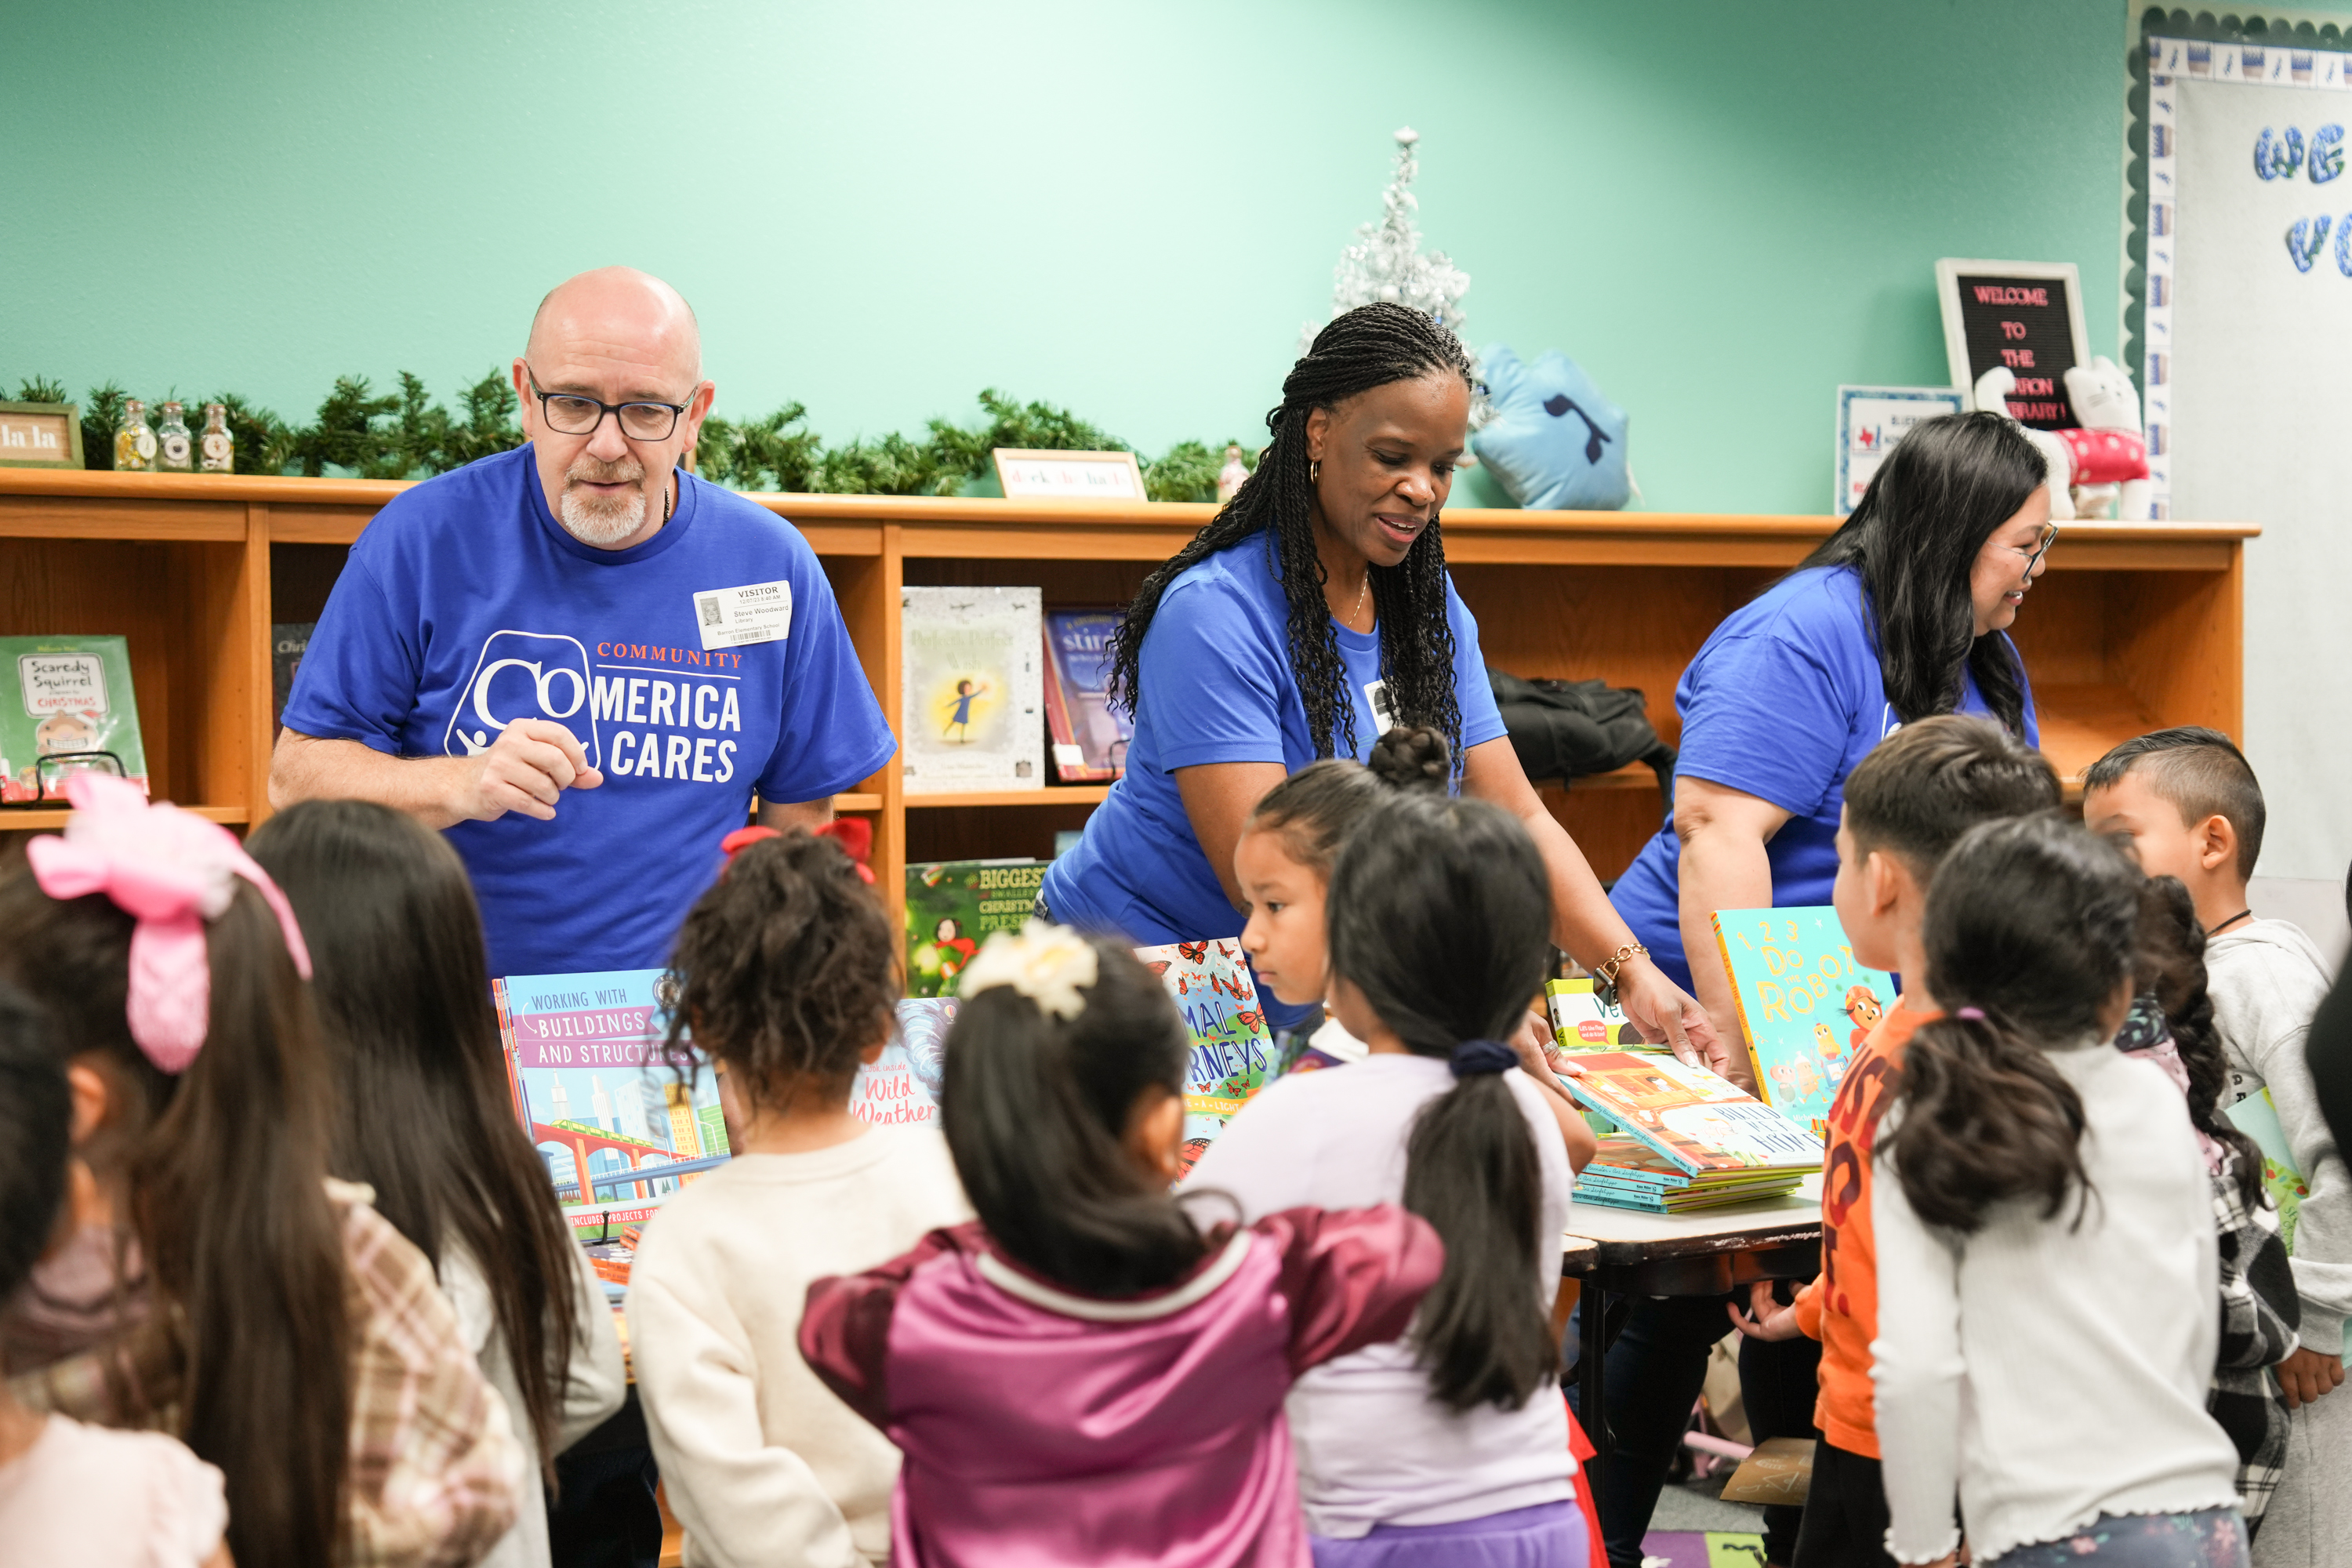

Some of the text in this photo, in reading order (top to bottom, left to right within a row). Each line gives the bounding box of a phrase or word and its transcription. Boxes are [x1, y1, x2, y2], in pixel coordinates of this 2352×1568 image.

[2254, 122, 2345, 183] WE
[1973, 285, 2048, 306] WELCOME
[2001, 321, 2027, 339] TO
[2001, 349, 2035, 368] THE
[2, 424, 56, 448] la la
[738, 586, 779, 598] VISITOR
[754, 604, 789, 615] Woodward
[735, 625, 762, 633] Elementary
[597, 641, 742, 668] COMMUNITY
[31, 660, 89, 676] Scaredy
[34, 675, 93, 688] Squirrel
[38, 697, 96, 708] CHRISTMAS
[611, 731, 737, 783] CARES
[979, 899, 1035, 914] CHRISTM
[1784, 975, 1802, 985] THE
[532, 989, 628, 1011] WORKING WITH
[1728, 972, 1735, 984] DO
[1737, 1003, 1748, 1029] ROBOT
[538, 1011, 645, 1038] BUILDINGS
[539, 1044, 688, 1063] AND STRUCTURES
[1186, 1037, 1267, 1083] RNEYS
[864, 1062, 907, 1073] Look inside
[866, 1073, 916, 1102] Wild
[853, 1099, 936, 1126] Weather
[1590, 1100, 1602, 1114] Emily
[1712, 1106, 1781, 1120] BUILD
[1745, 1120, 1777, 1132] ME
[1793, 1113, 1819, 1122] Michelle
[1749, 1132, 1825, 1153] HOME
[570, 1215, 604, 1226] INCLUDES
[608, 1210, 643, 1222] PROJECTS
